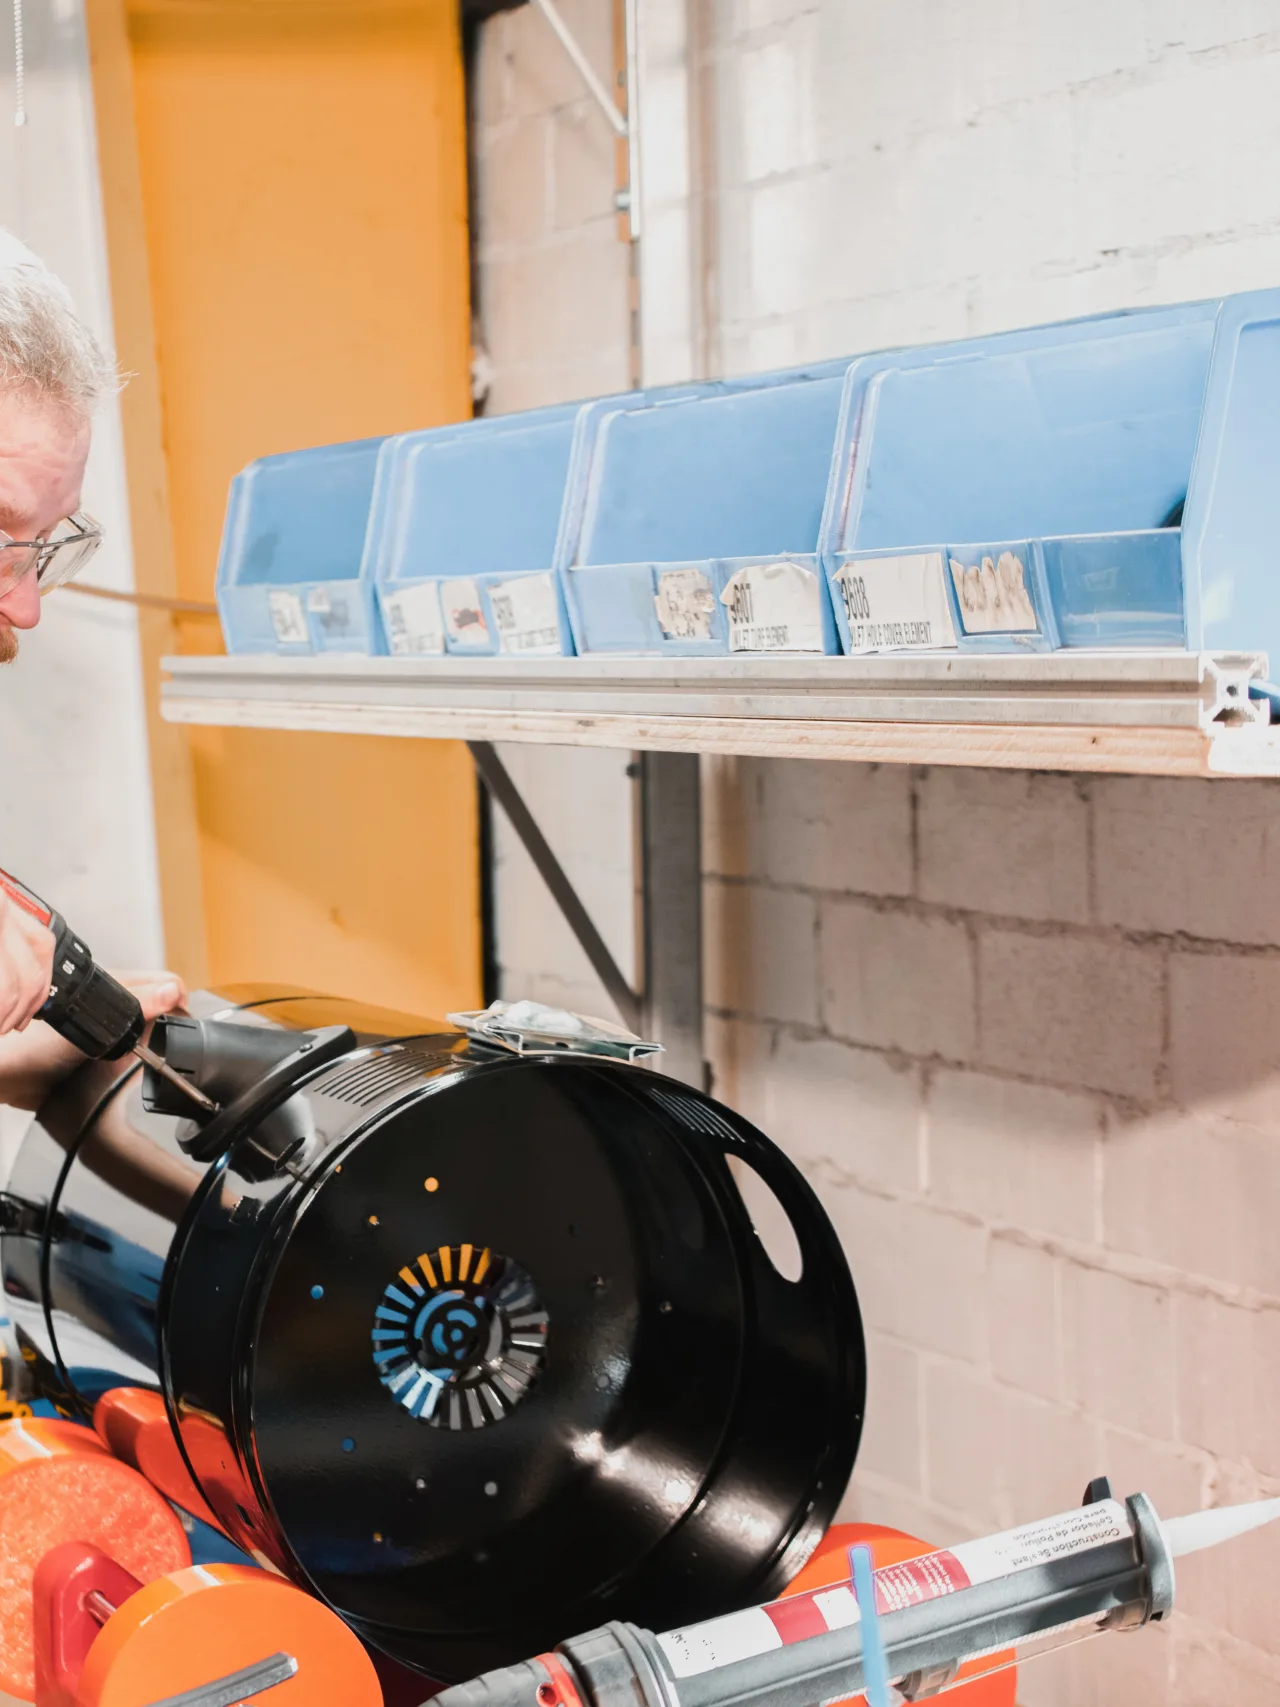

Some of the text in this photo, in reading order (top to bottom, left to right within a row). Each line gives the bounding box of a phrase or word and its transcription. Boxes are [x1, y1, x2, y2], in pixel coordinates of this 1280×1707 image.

[840, 576, 870, 620] 9608
[866, 622, 883, 646] HOLE
[883, 621, 904, 646] COVER
[904, 620, 932, 645] ELEMENT
[62, 960, 75, 975] 10
[1051, 1527, 1120, 1553] Construction
[1055, 1530, 1070, 1538] de
